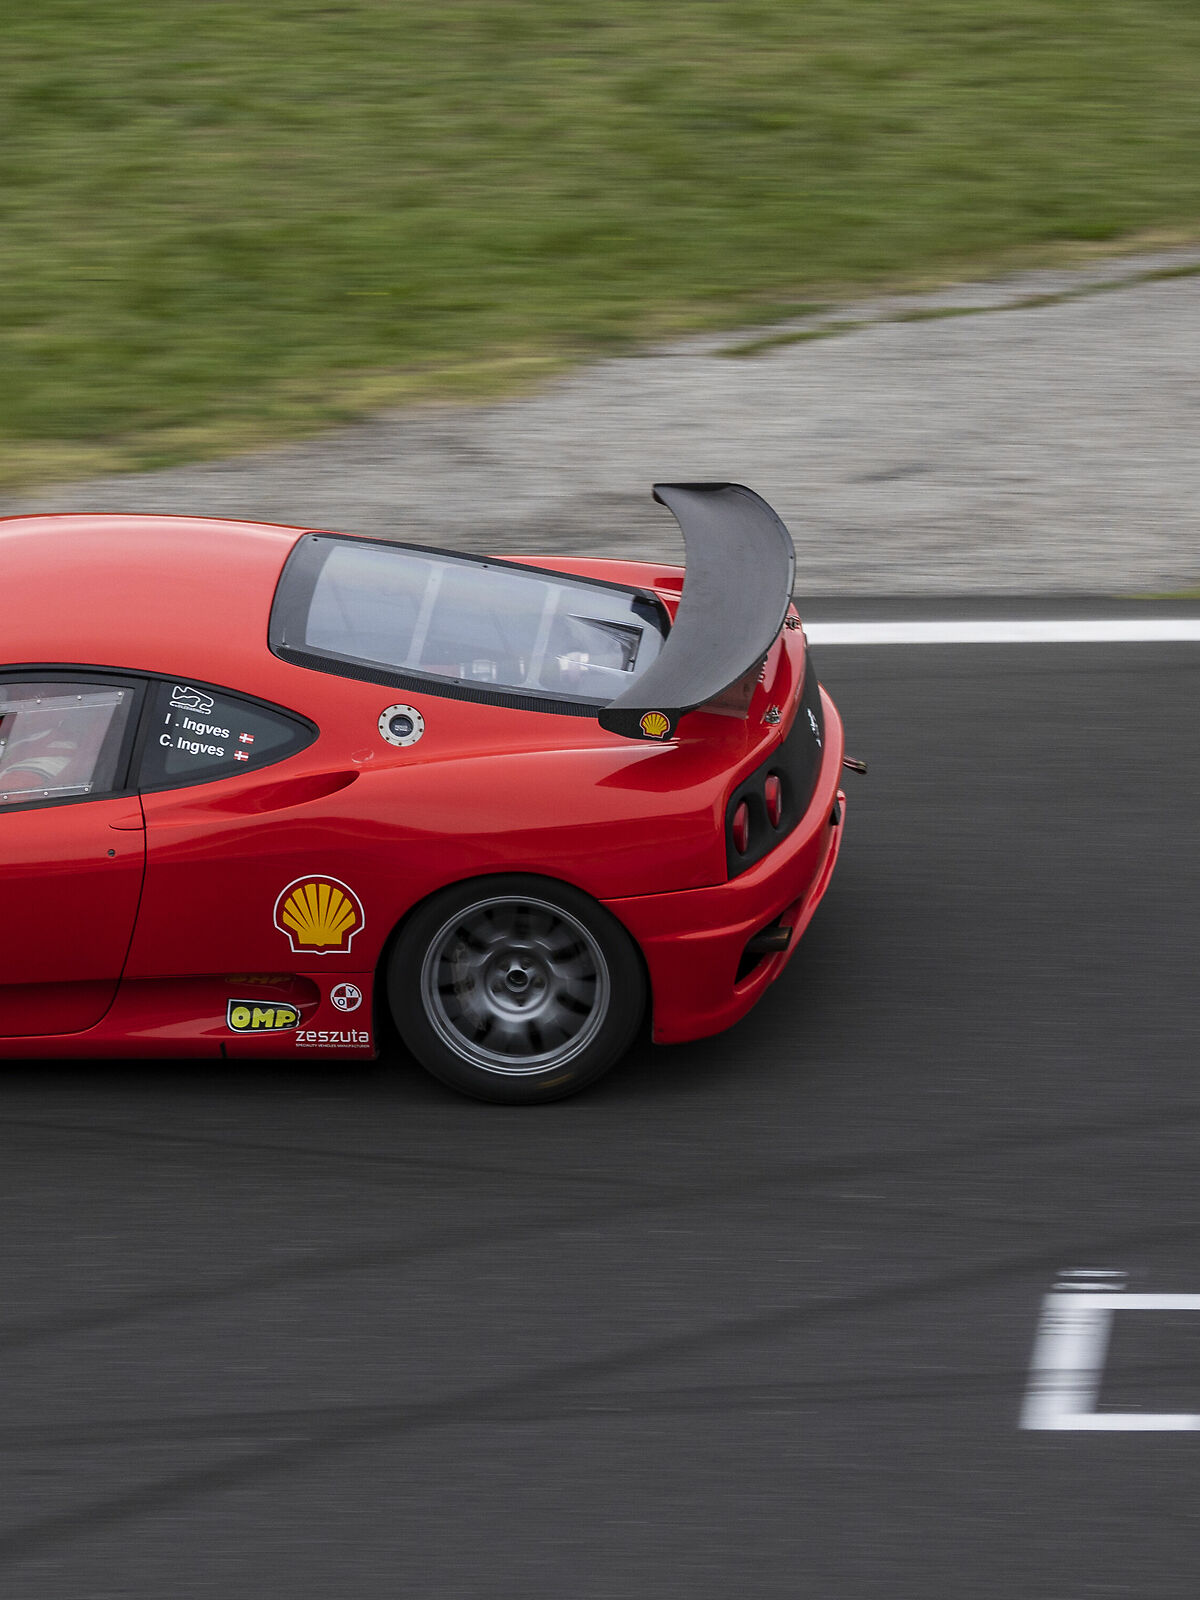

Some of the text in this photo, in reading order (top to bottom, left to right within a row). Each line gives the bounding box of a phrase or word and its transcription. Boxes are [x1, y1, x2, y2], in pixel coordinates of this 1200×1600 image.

[182, 717, 230, 739] Ingves
[159, 733, 225, 757] C. Ingves
[230, 1006, 297, 1029] OMP
[295, 1029, 369, 1043] zeszuta
